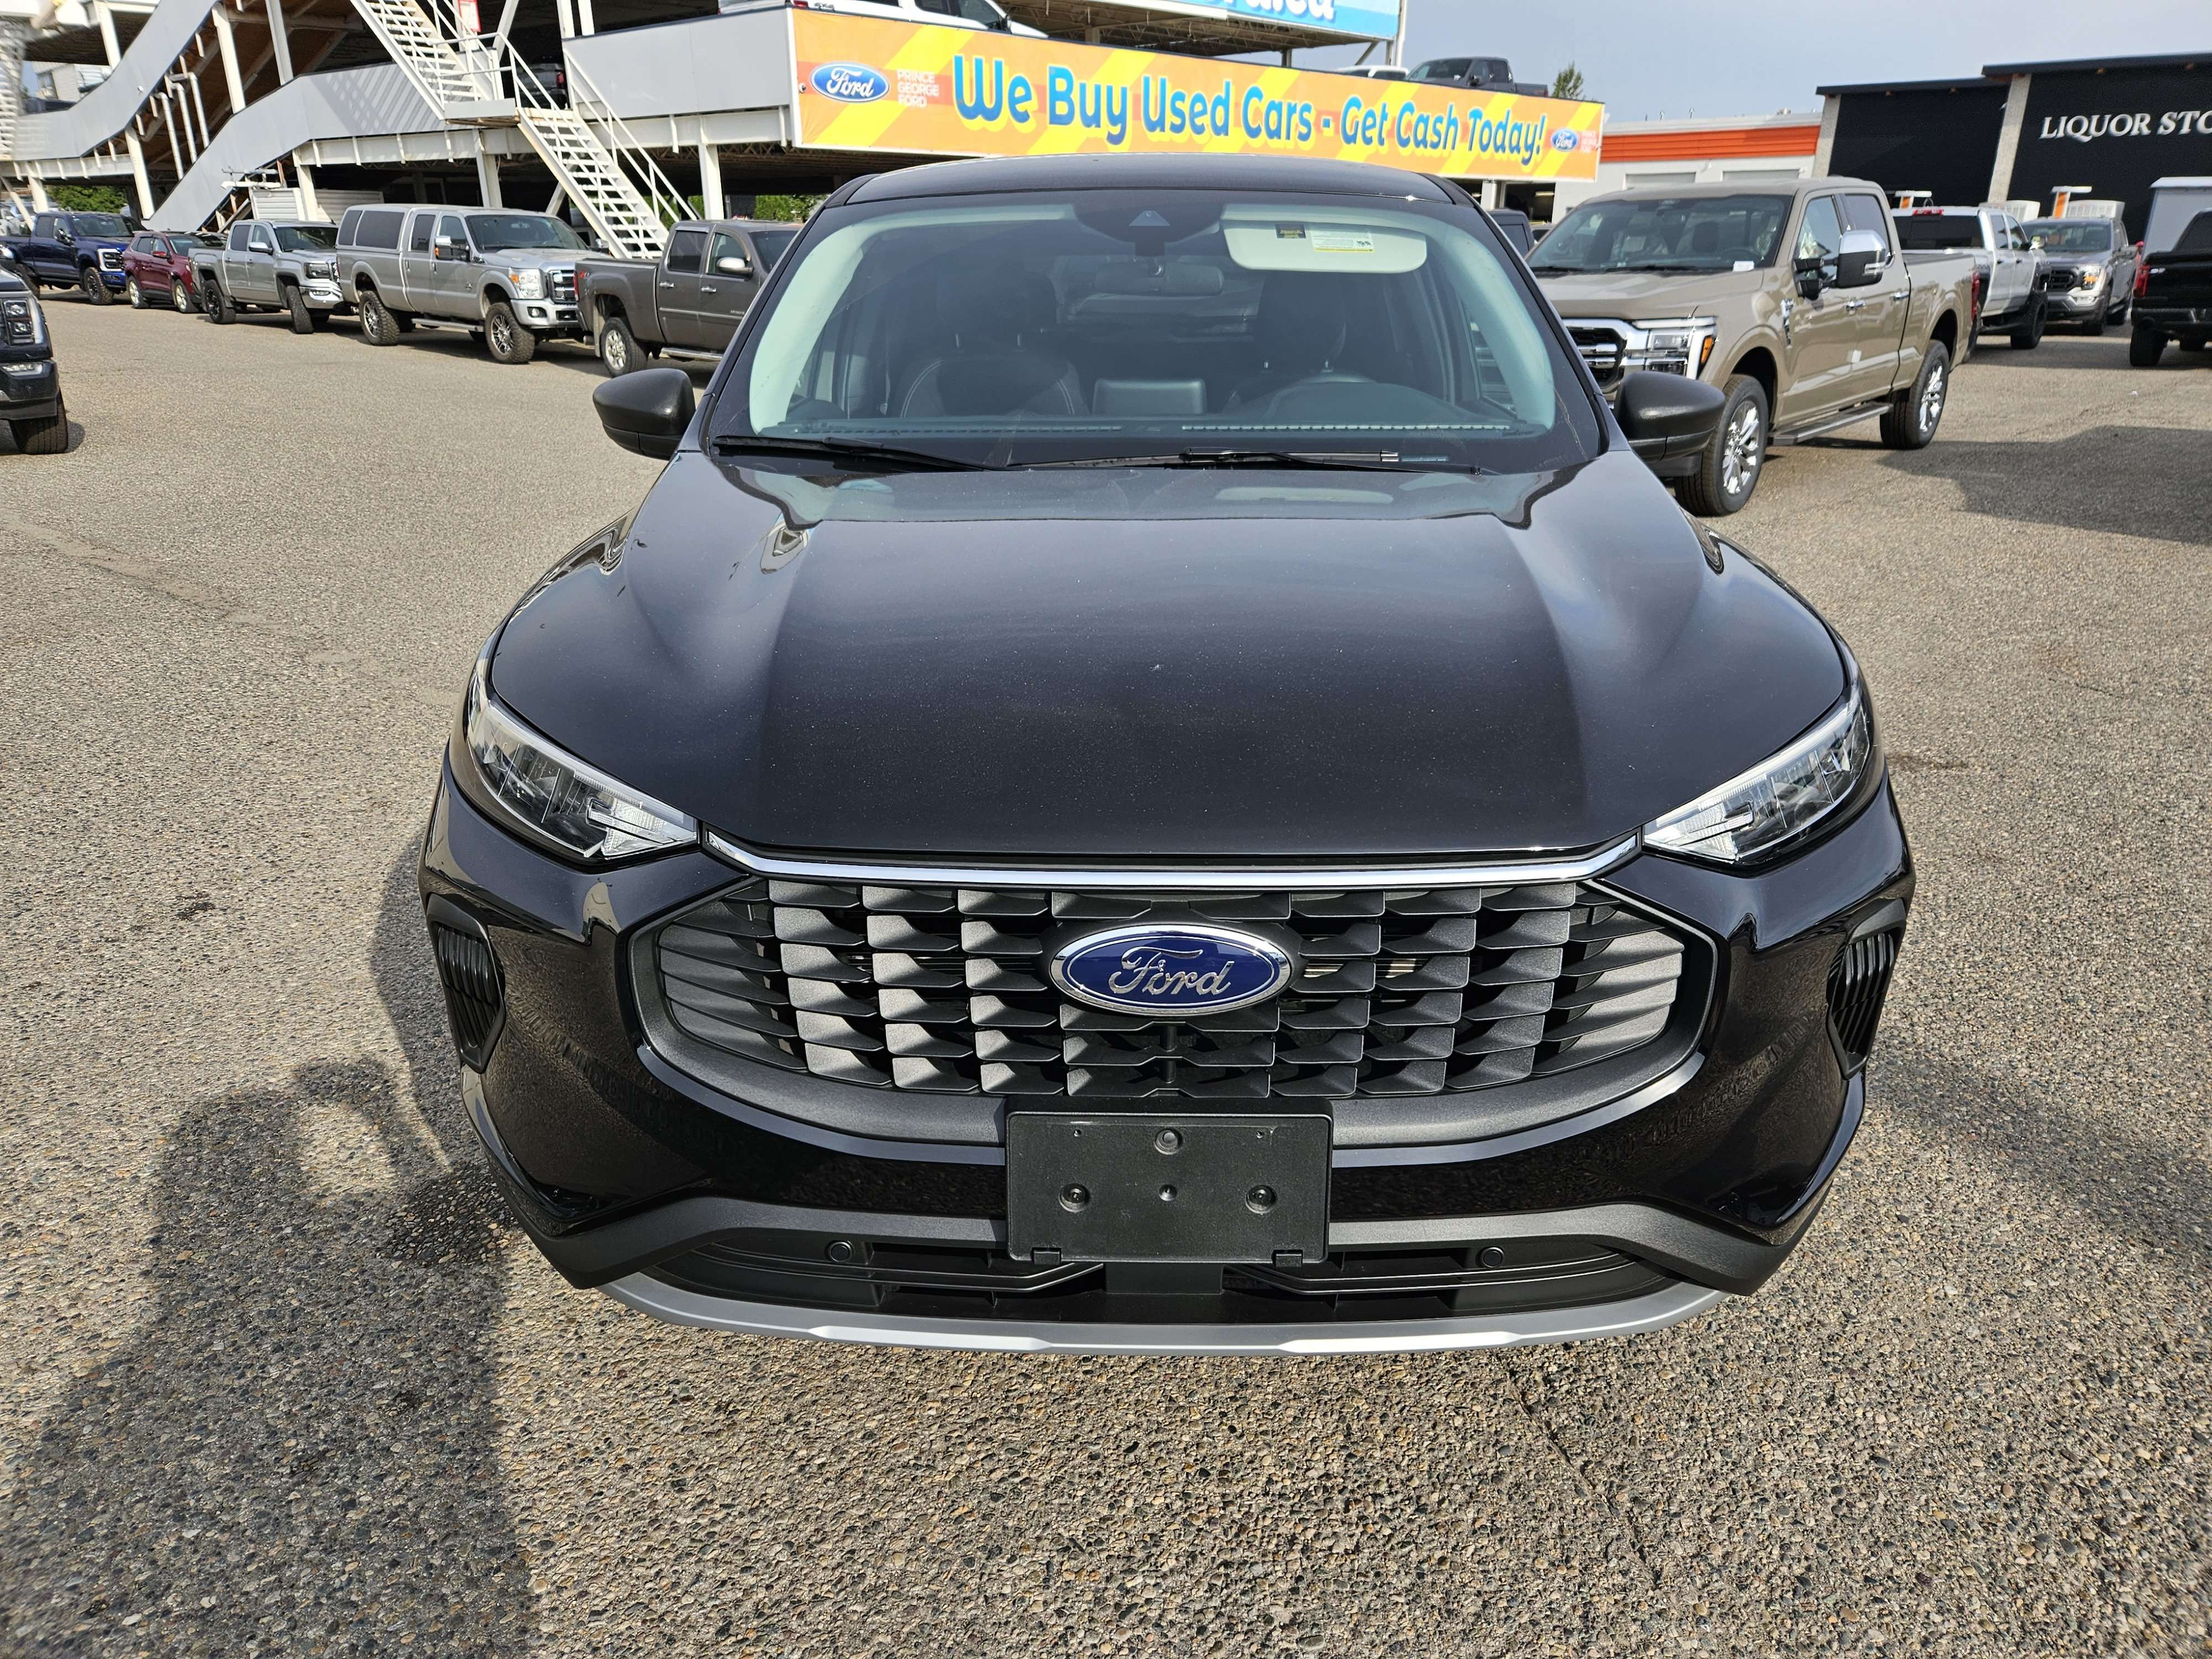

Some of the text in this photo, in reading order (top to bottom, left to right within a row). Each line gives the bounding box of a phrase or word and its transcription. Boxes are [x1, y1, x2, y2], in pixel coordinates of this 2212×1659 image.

[826, 67, 875, 97] Ford
[896, 69, 935, 84] PRINCE
[897, 81, 940, 97] GEORGE
[898, 94, 927, 108] FORD
[953, 54, 1032, 123] We
[1048, 65, 1128, 145] Buy
[1142, 75, 1232, 137] Used
[1242, 86, 1312, 142] Cars
[1341, 96, 1389, 147] Get
[1395, 101, 1459, 150] Cash
[1468, 108, 1547, 165] Today!
[2039, 113, 2152, 143] LIQUOR
[1108, 946, 1234, 995] Ford
